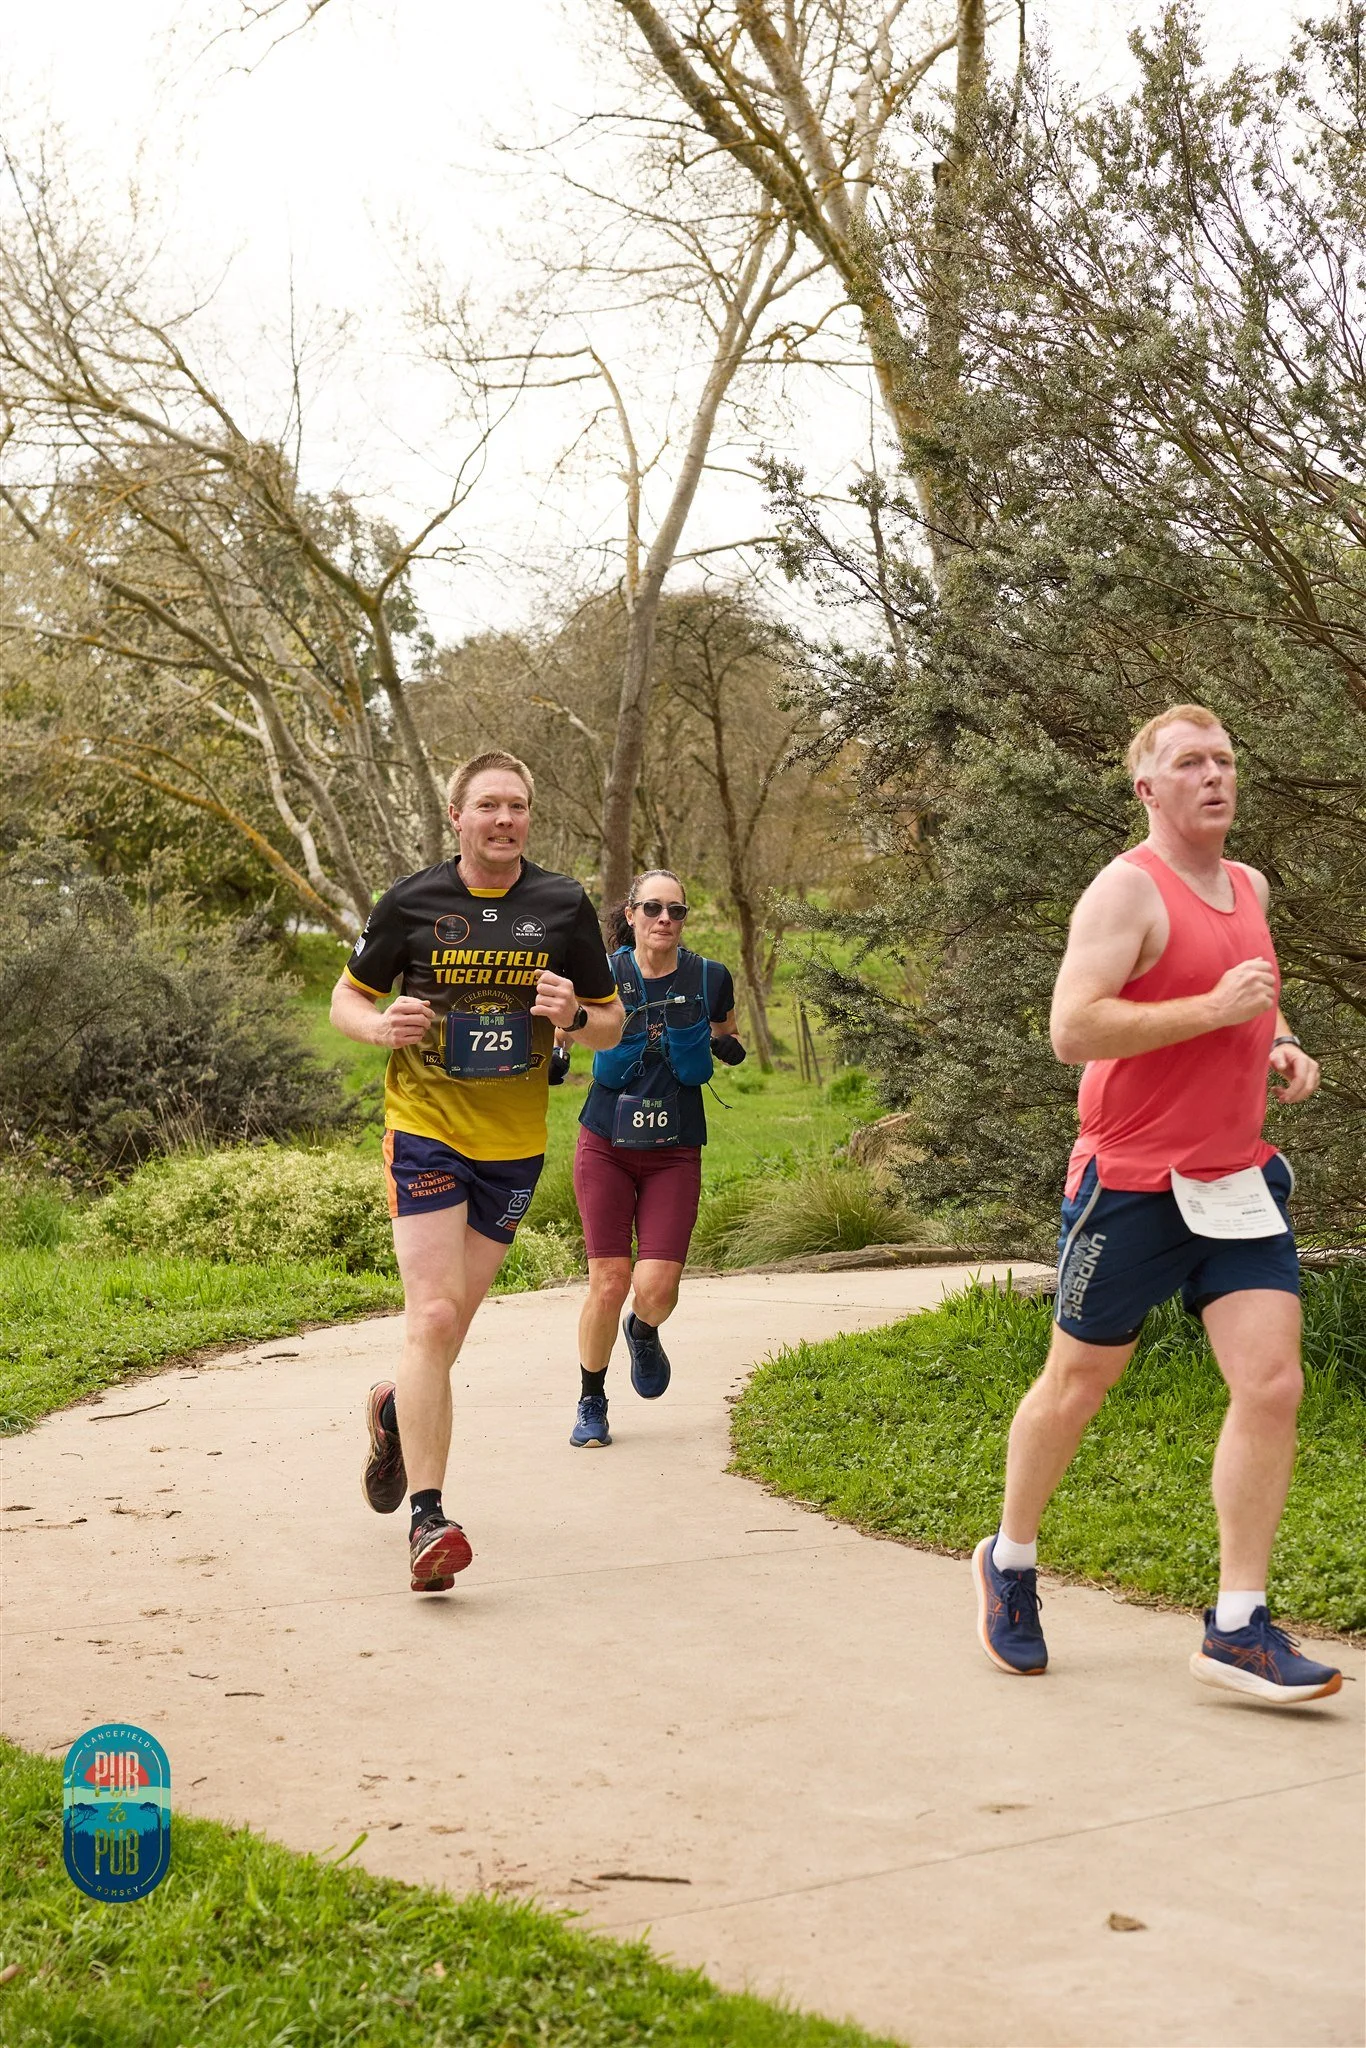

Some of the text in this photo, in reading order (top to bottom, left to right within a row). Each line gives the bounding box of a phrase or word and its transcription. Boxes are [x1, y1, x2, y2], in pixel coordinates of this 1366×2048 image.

[431, 950, 549, 968] LANCEFIELD
[433, 968, 492, 984] TIGER
[464, 989, 513, 1004] CELEBRATING
[479, 1015, 490, 1025] PUB
[494, 1015, 505, 1025] PUB
[469, 1030, 513, 1052] 725
[632, 1111, 668, 1128] 816
[411, 1181, 456, 1198] SERVICES
[1070, 1233, 1107, 1305] UNDER
